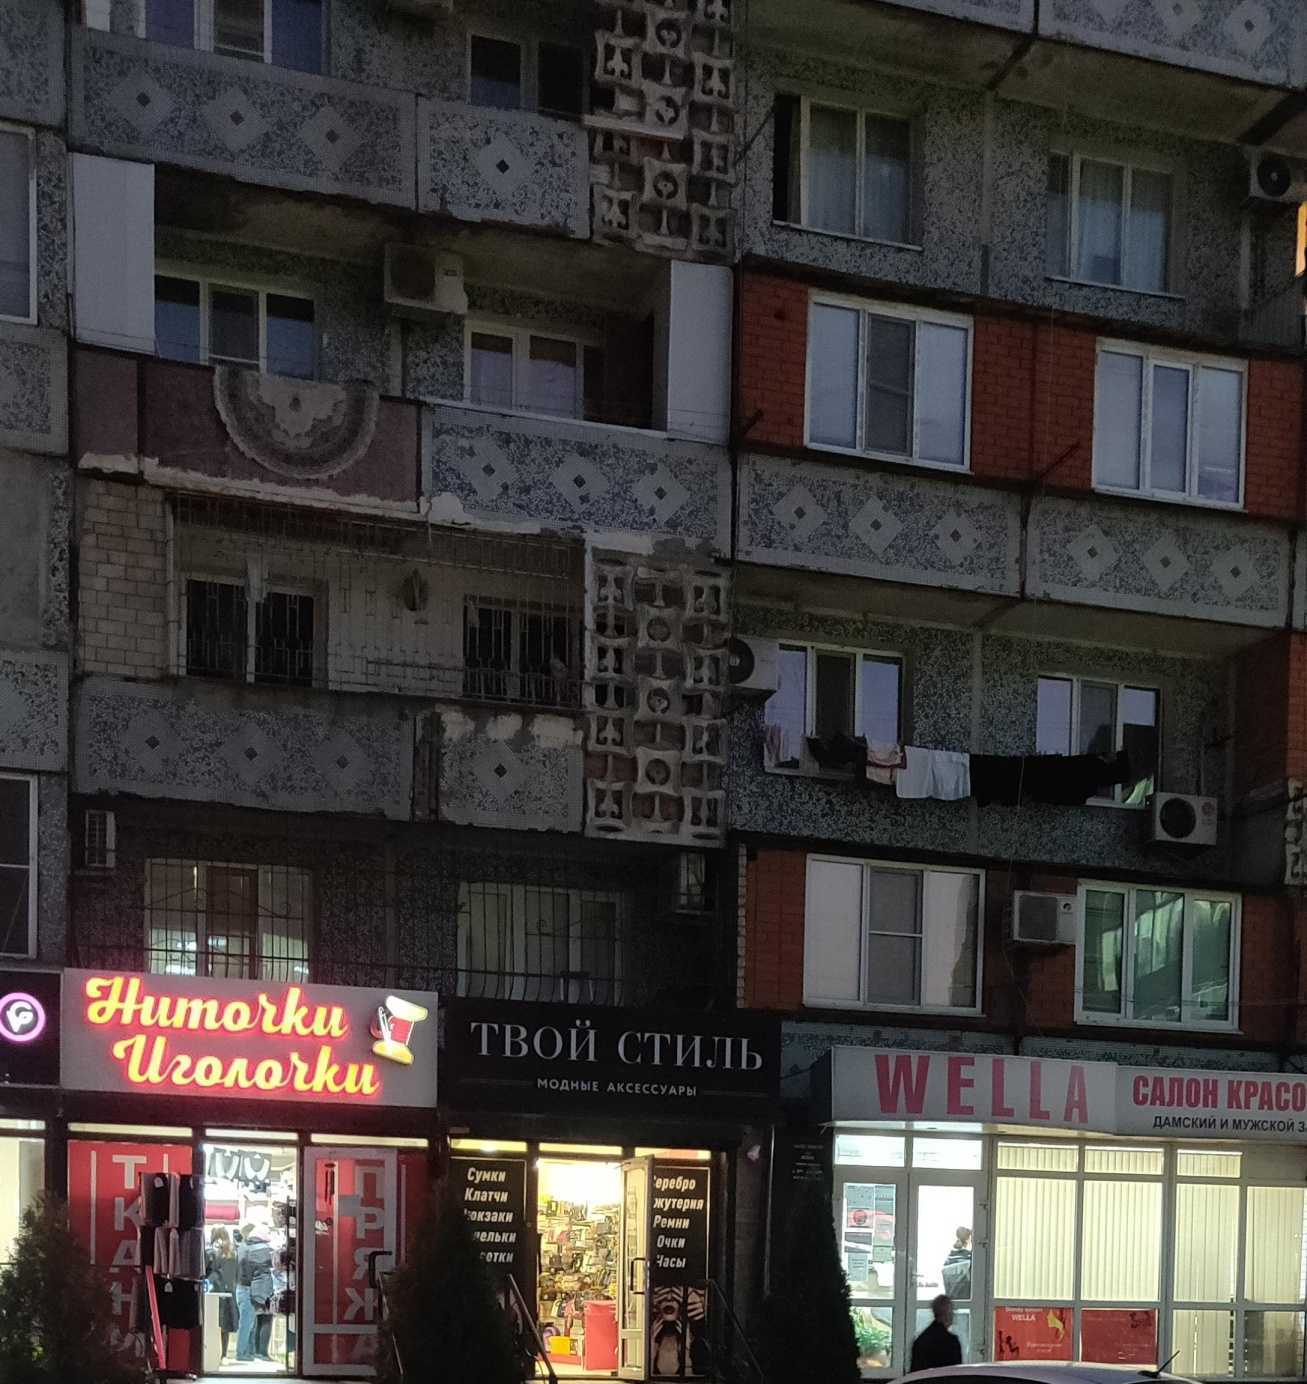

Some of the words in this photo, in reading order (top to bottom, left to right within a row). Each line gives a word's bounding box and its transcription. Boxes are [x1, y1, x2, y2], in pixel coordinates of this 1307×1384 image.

[85, 976, 348, 1038] Ниточки
[470, 1020, 598, 1062] ТВОЙ
[617, 1031, 763, 1071] СТИЛЬ
[112, 1034, 379, 1095] Иголочки
[537, 1077, 599, 1094] МОДНЫЕ
[607, 1082, 697, 1097] АКСЕССУАРЫ
[874, 1054, 1089, 1124] WELLA
[1132, 1075, 1219, 1109] САЛОН
[1226, 1079, 1306, 1112] КРАСО
[1153, 1115, 1216, 1129] ДАМСКИЙ
[1220, 1120, 1228, 1129] И
[1232, 1119, 1294, 1132] МУЖСКОЙ
[1298, 1121, 1307, 1133] З
[467, 1167, 506, 1183] Сумки
[653, 1176, 696, 1192] еребро
[464, 1187, 509, 1202] Клатчи
[653, 1197, 704, 1212] жутерия
[653, 1215, 690, 1229] Ремни
[656, 1235, 686, 1248] Очки
[656, 1254, 686, 1268] Часы
[1011, 1314, 1036, 1322] WELLA
